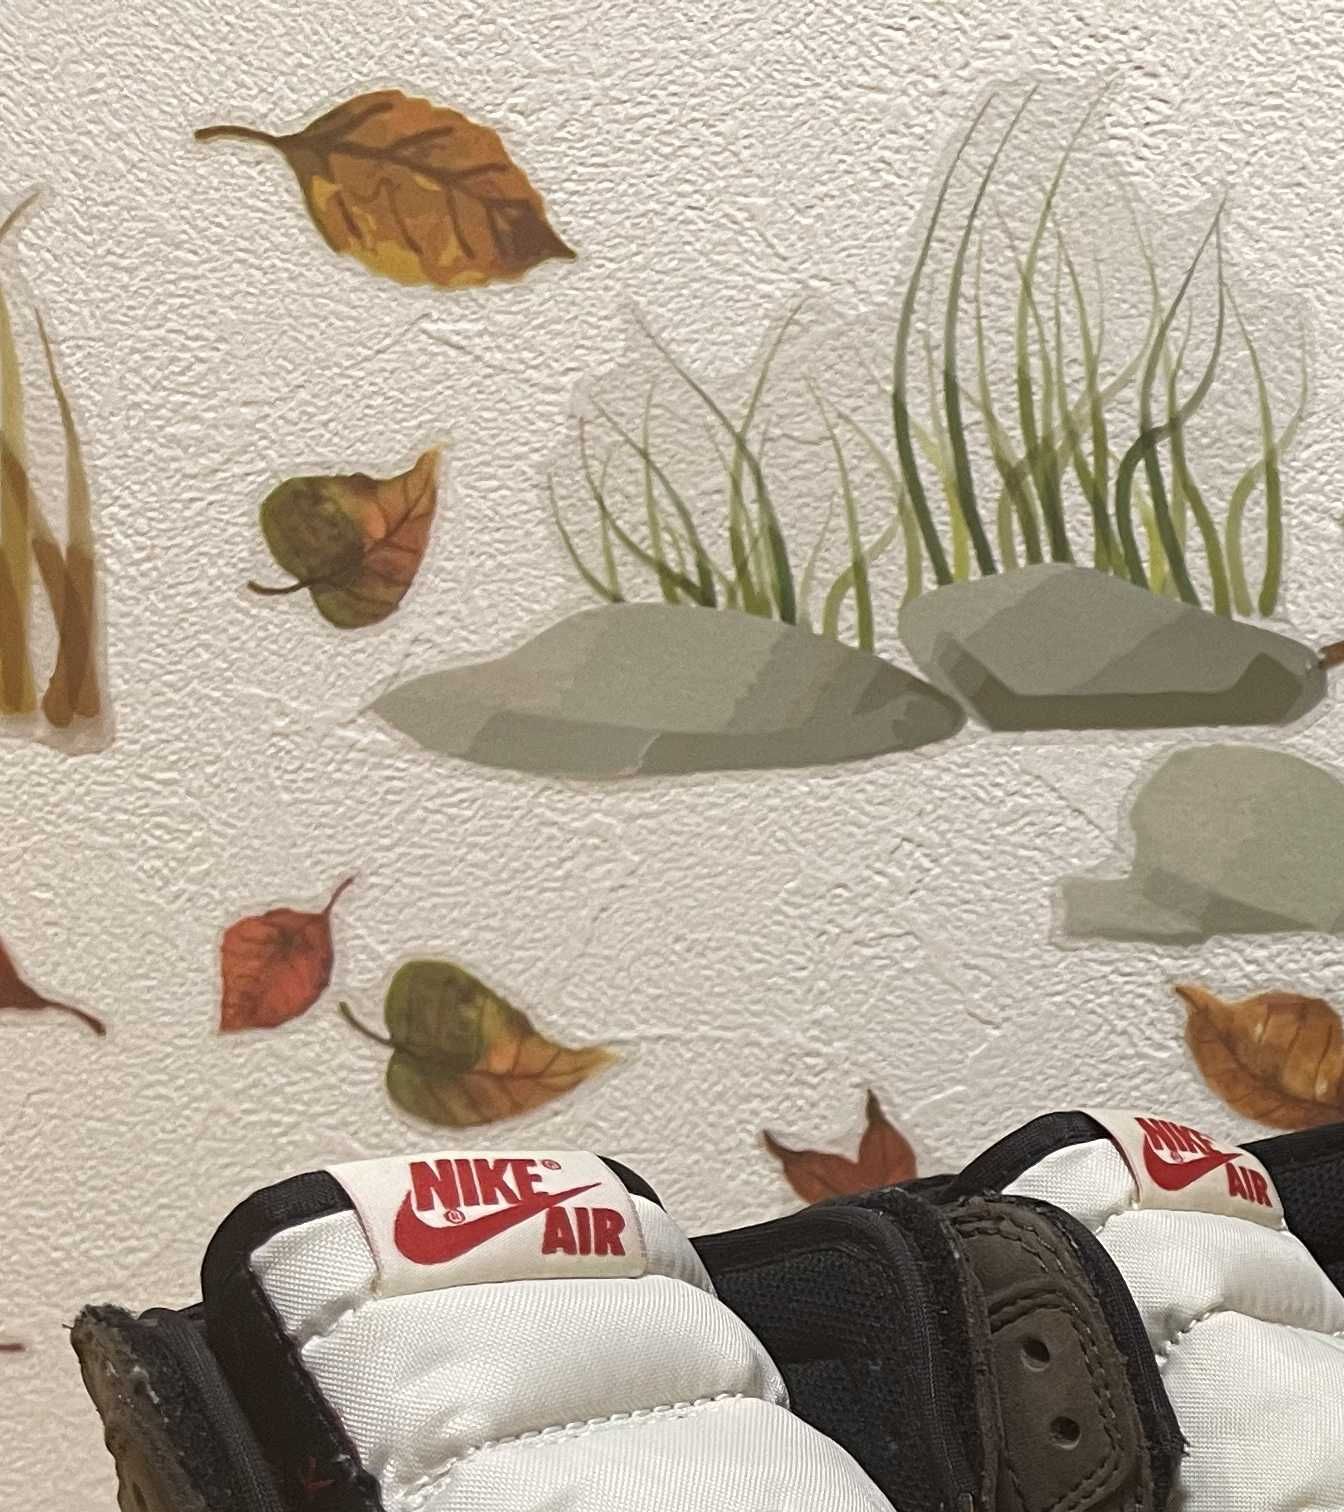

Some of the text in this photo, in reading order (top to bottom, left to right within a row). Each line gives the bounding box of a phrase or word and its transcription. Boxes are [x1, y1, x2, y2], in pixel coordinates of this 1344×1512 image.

[1134, 1116, 1217, 1156] NIKE
[409, 1158, 548, 1211] NIKE
[1225, 1162, 1273, 1208] AIR
[541, 1206, 626, 1256] AIR
